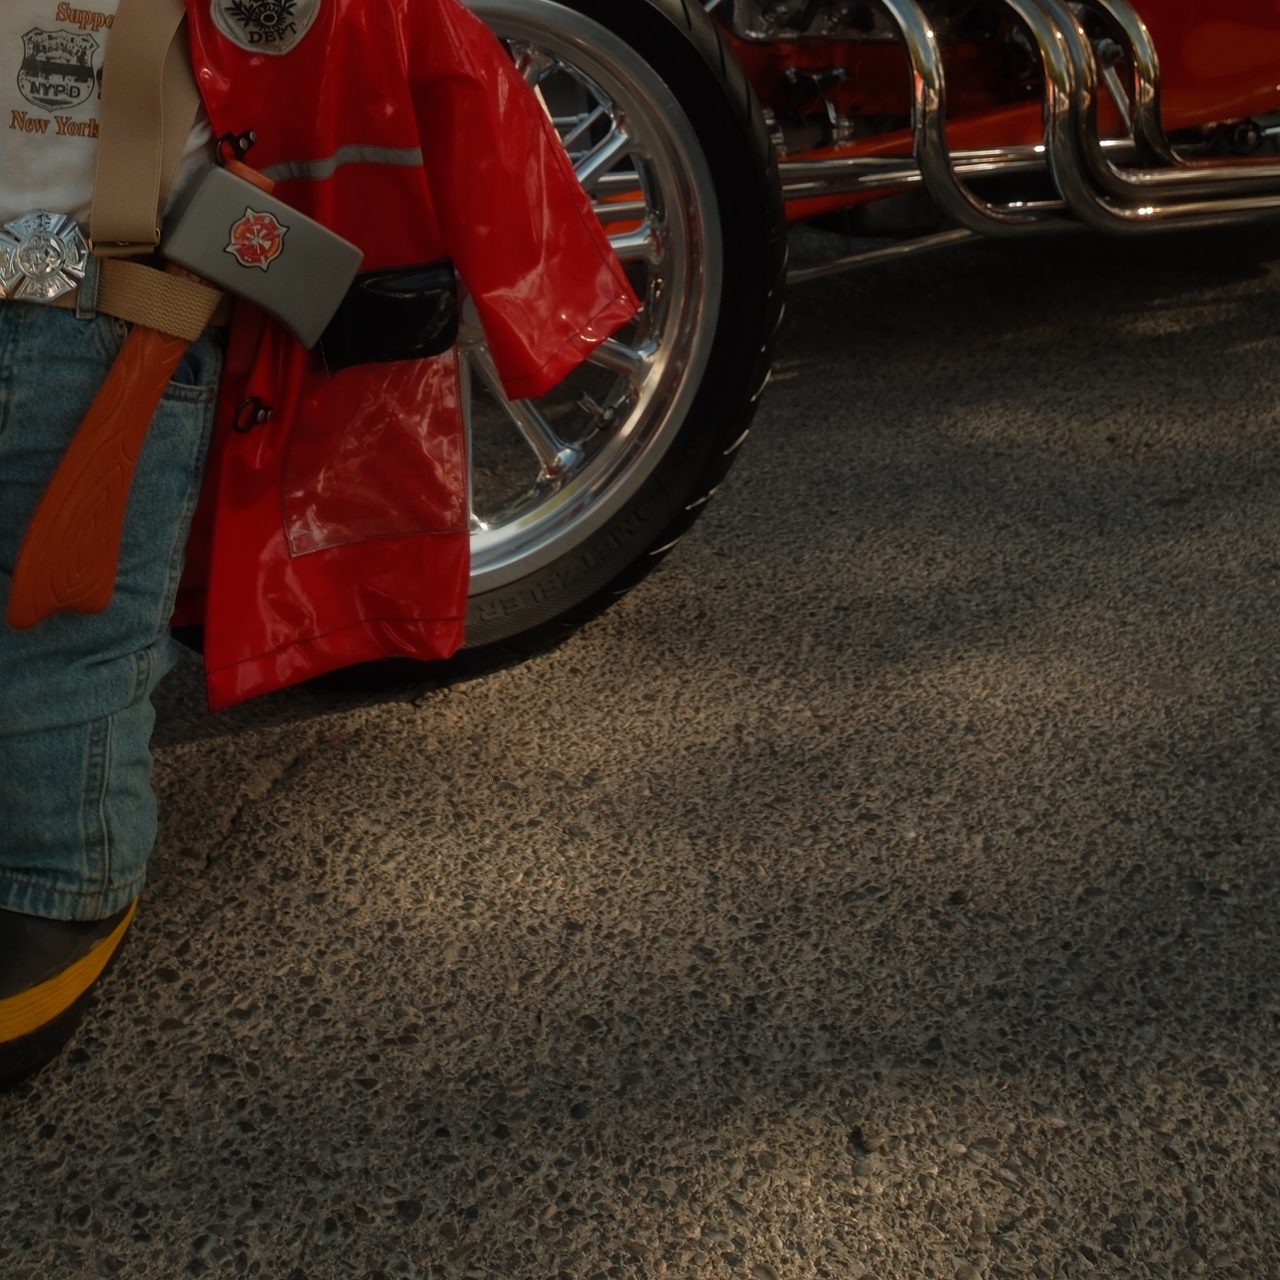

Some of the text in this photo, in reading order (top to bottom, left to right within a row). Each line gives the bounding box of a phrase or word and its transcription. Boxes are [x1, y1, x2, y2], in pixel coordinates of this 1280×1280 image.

[248, 22, 297, 44] DEPT
[30, 81, 81, 99] NYPD
[9, 110, 50, 134] New
